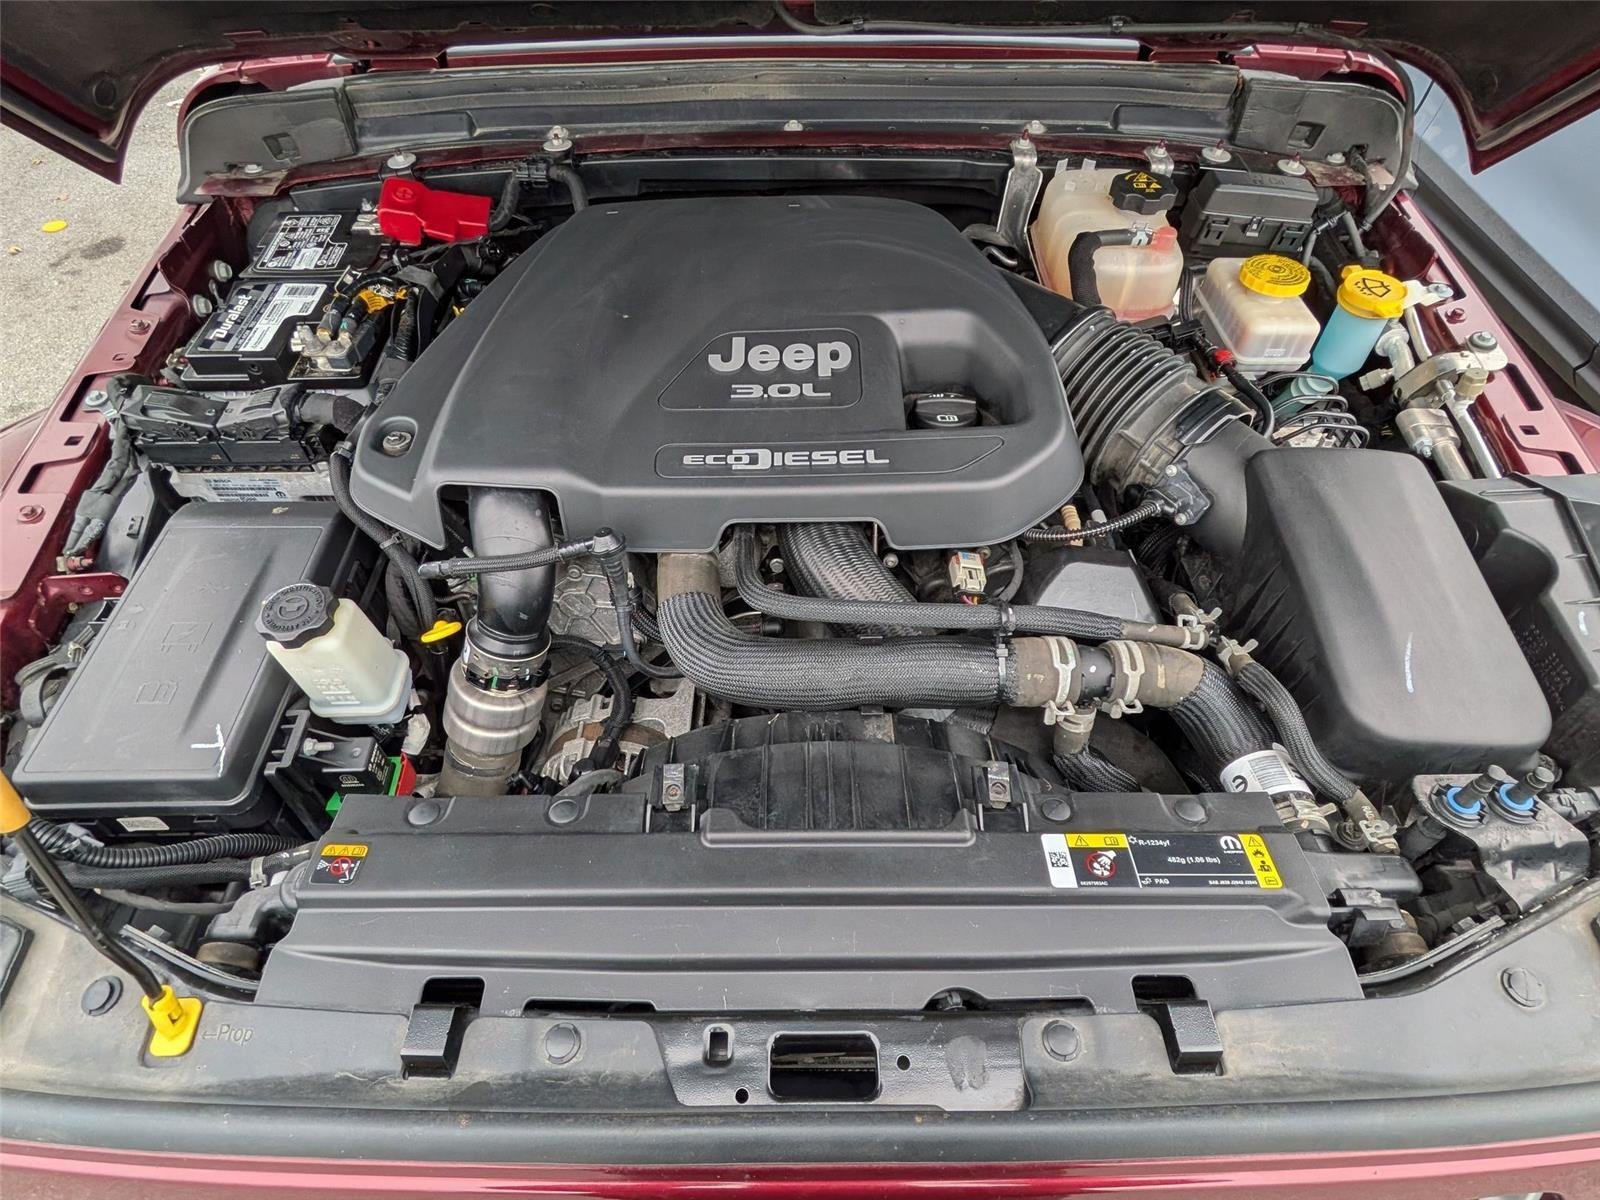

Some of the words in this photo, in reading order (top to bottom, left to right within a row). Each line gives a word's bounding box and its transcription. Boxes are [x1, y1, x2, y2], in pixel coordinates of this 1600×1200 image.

[210, 294, 252, 339] Duralast
[708, 337, 852, 377] Jeep
[731, 383, 831, 398] 3.0L
[1139, 839, 1170, 847] R-1234yf
[1167, 856, 1186, 864] 482g
[1206, 856, 1221, 864] lbs)
[218, 1024, 254, 1046] Prop
